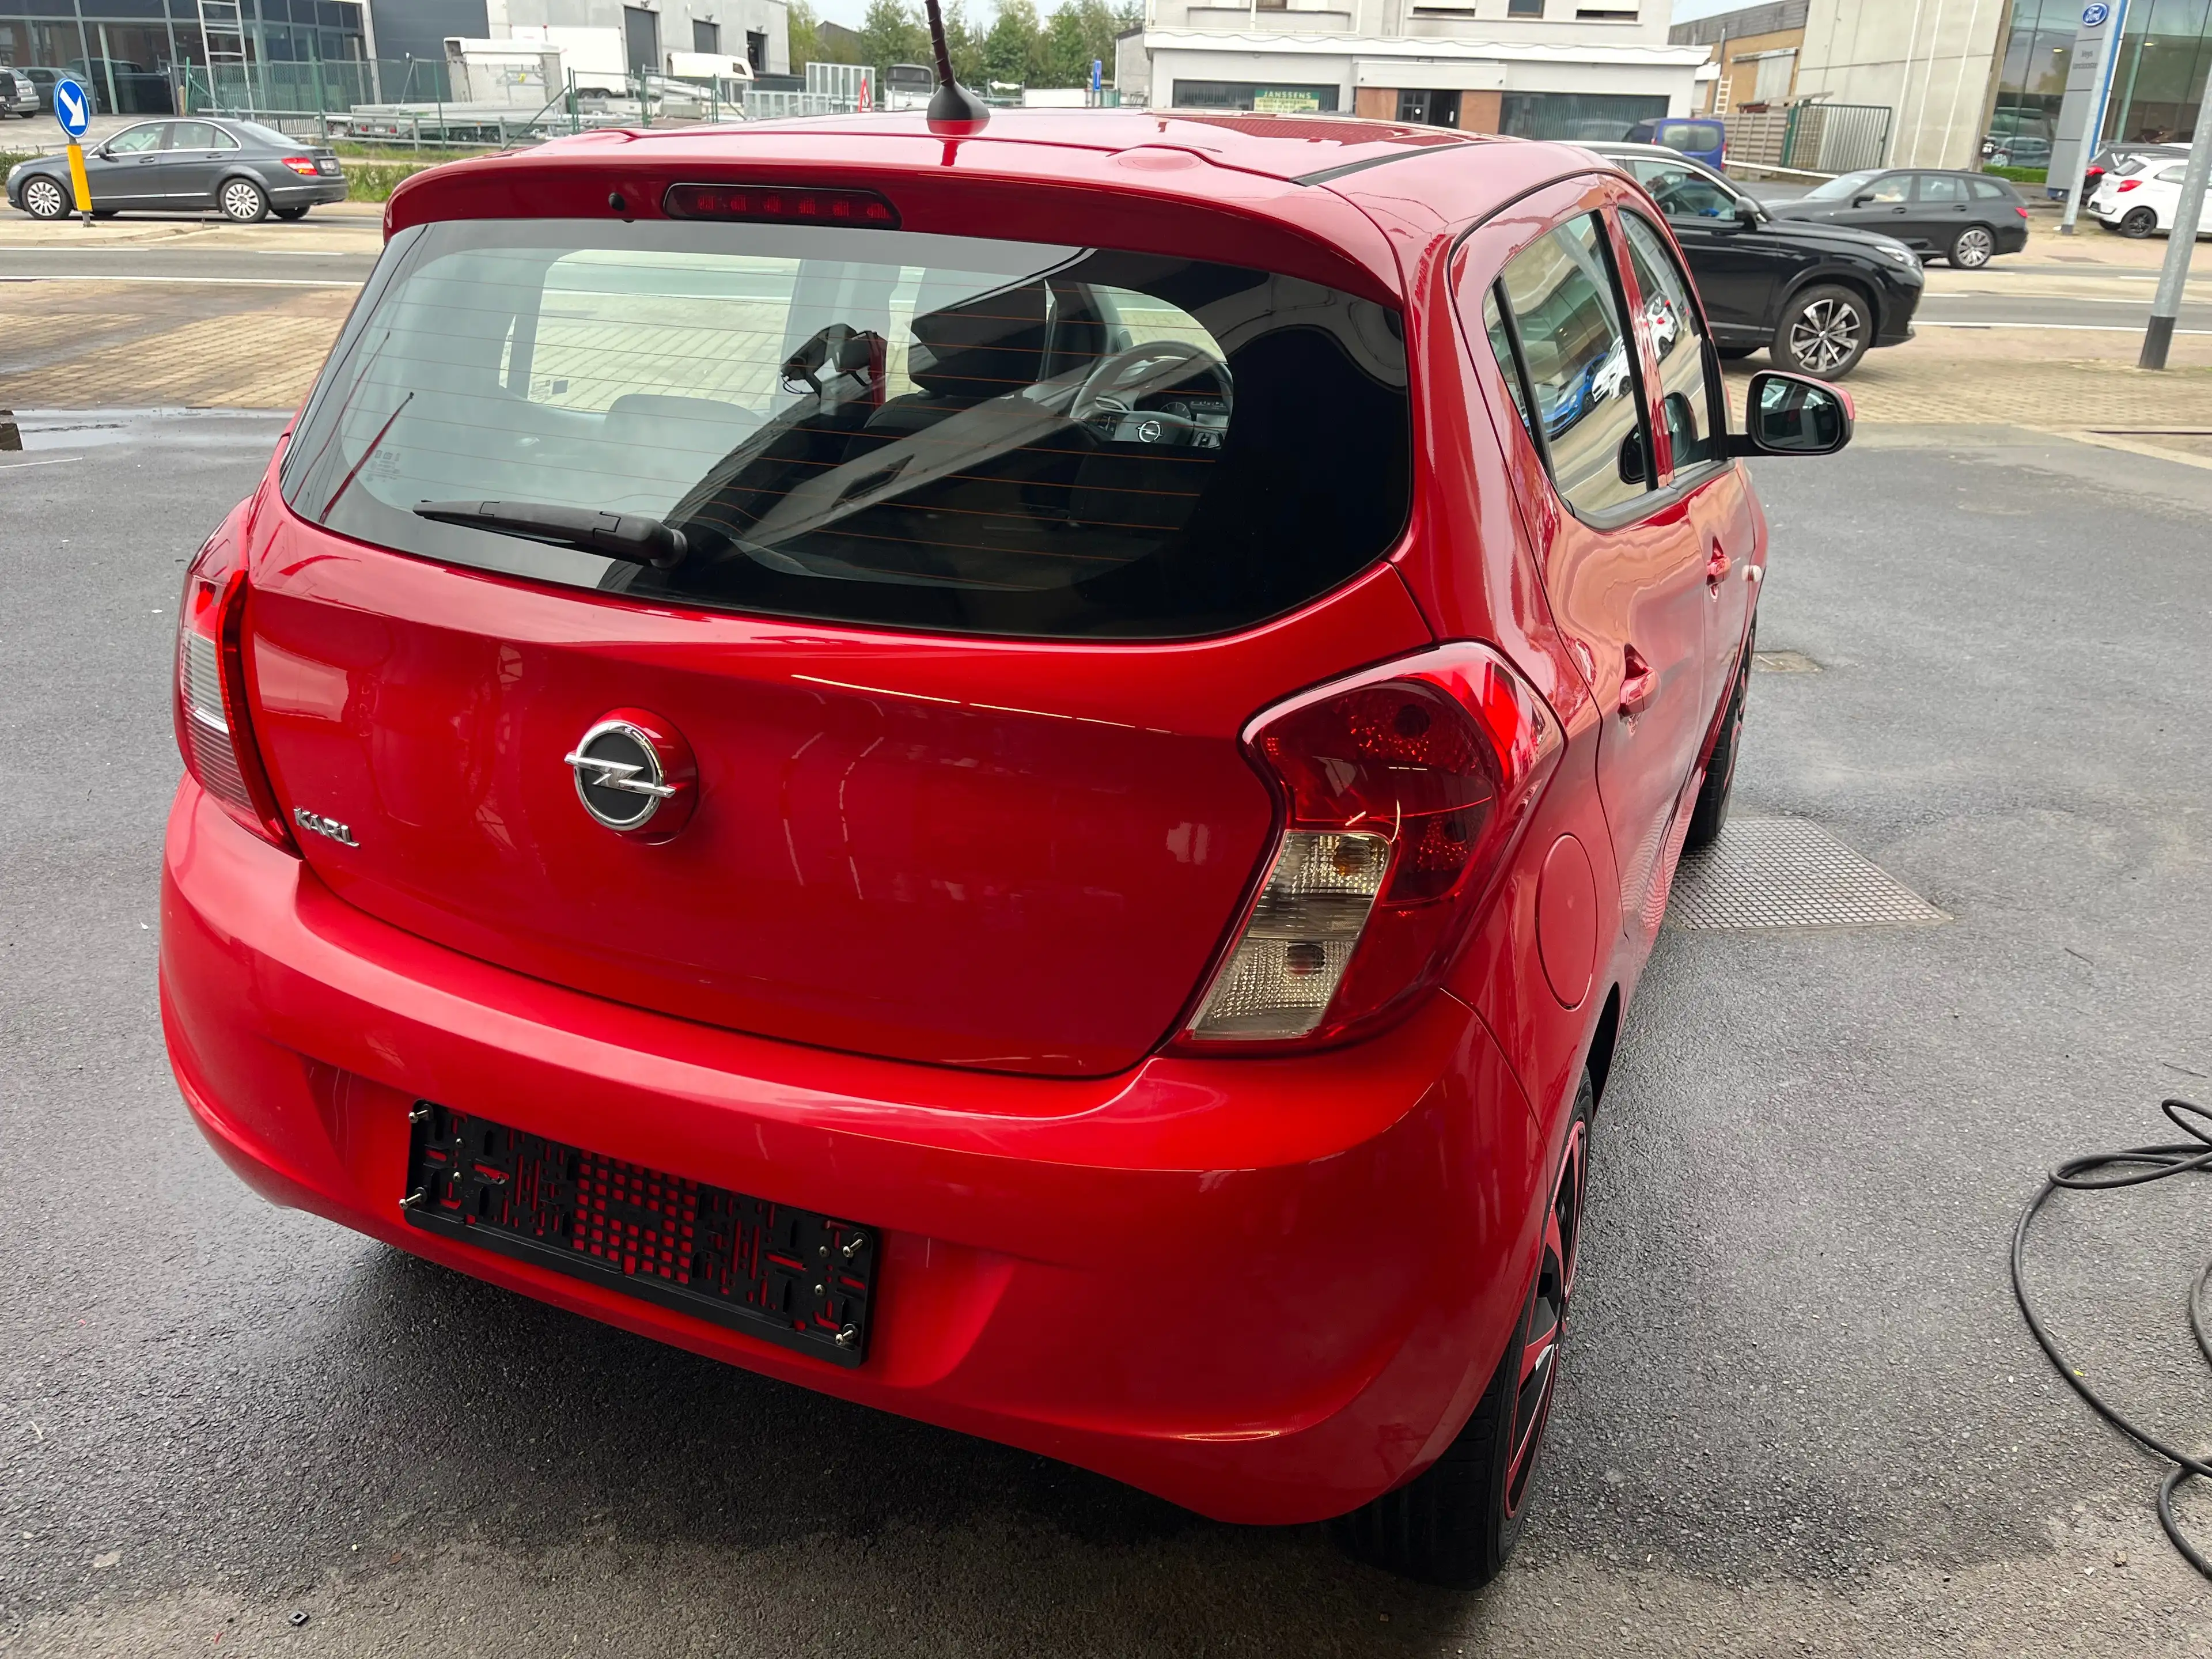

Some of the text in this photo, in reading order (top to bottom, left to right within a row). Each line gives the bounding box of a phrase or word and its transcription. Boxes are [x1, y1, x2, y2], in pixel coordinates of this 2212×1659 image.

[2085, 6, 2104, 22] Ford
[1263, 91, 1312, 99] JANSSENS
[294, 808, 359, 848] KARL
